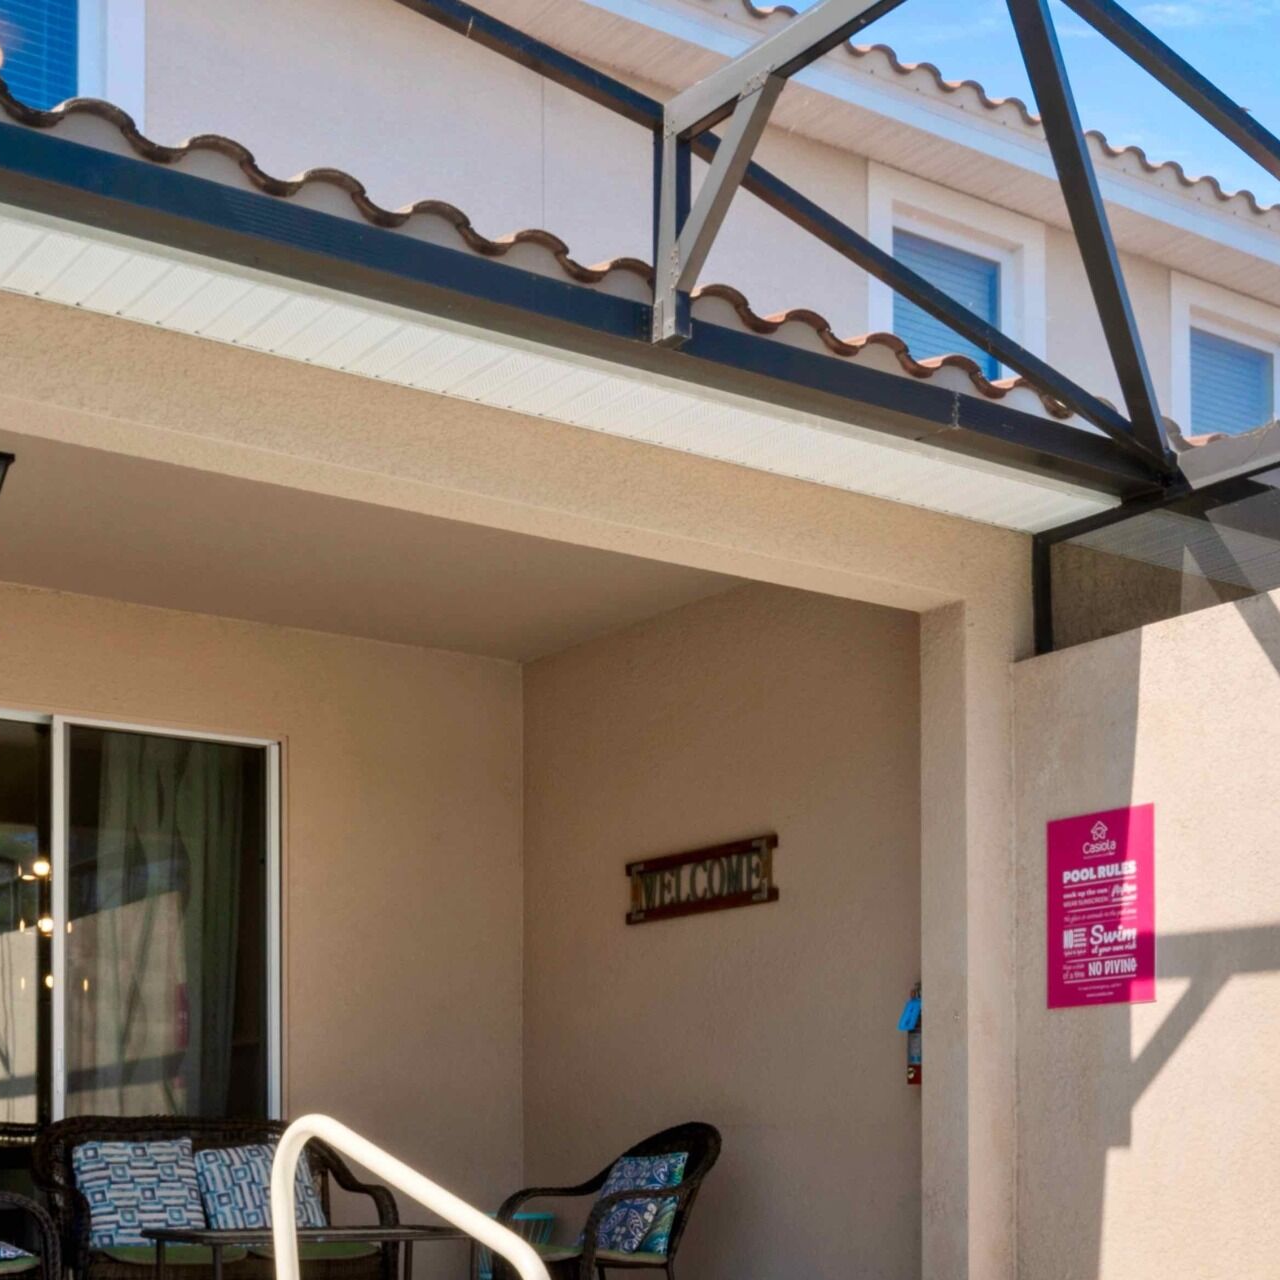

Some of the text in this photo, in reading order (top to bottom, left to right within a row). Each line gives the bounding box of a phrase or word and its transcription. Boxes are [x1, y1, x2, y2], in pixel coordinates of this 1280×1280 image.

[1082, 839, 1117, 855] Casiola
[643, 852, 762, 909] WELCOME
[1063, 860, 1137, 884] POOL RULES
[1089, 924, 1137, 945] Swim
[1088, 961, 1103, 977] NO
[1104, 957, 1137, 975] DIVING
